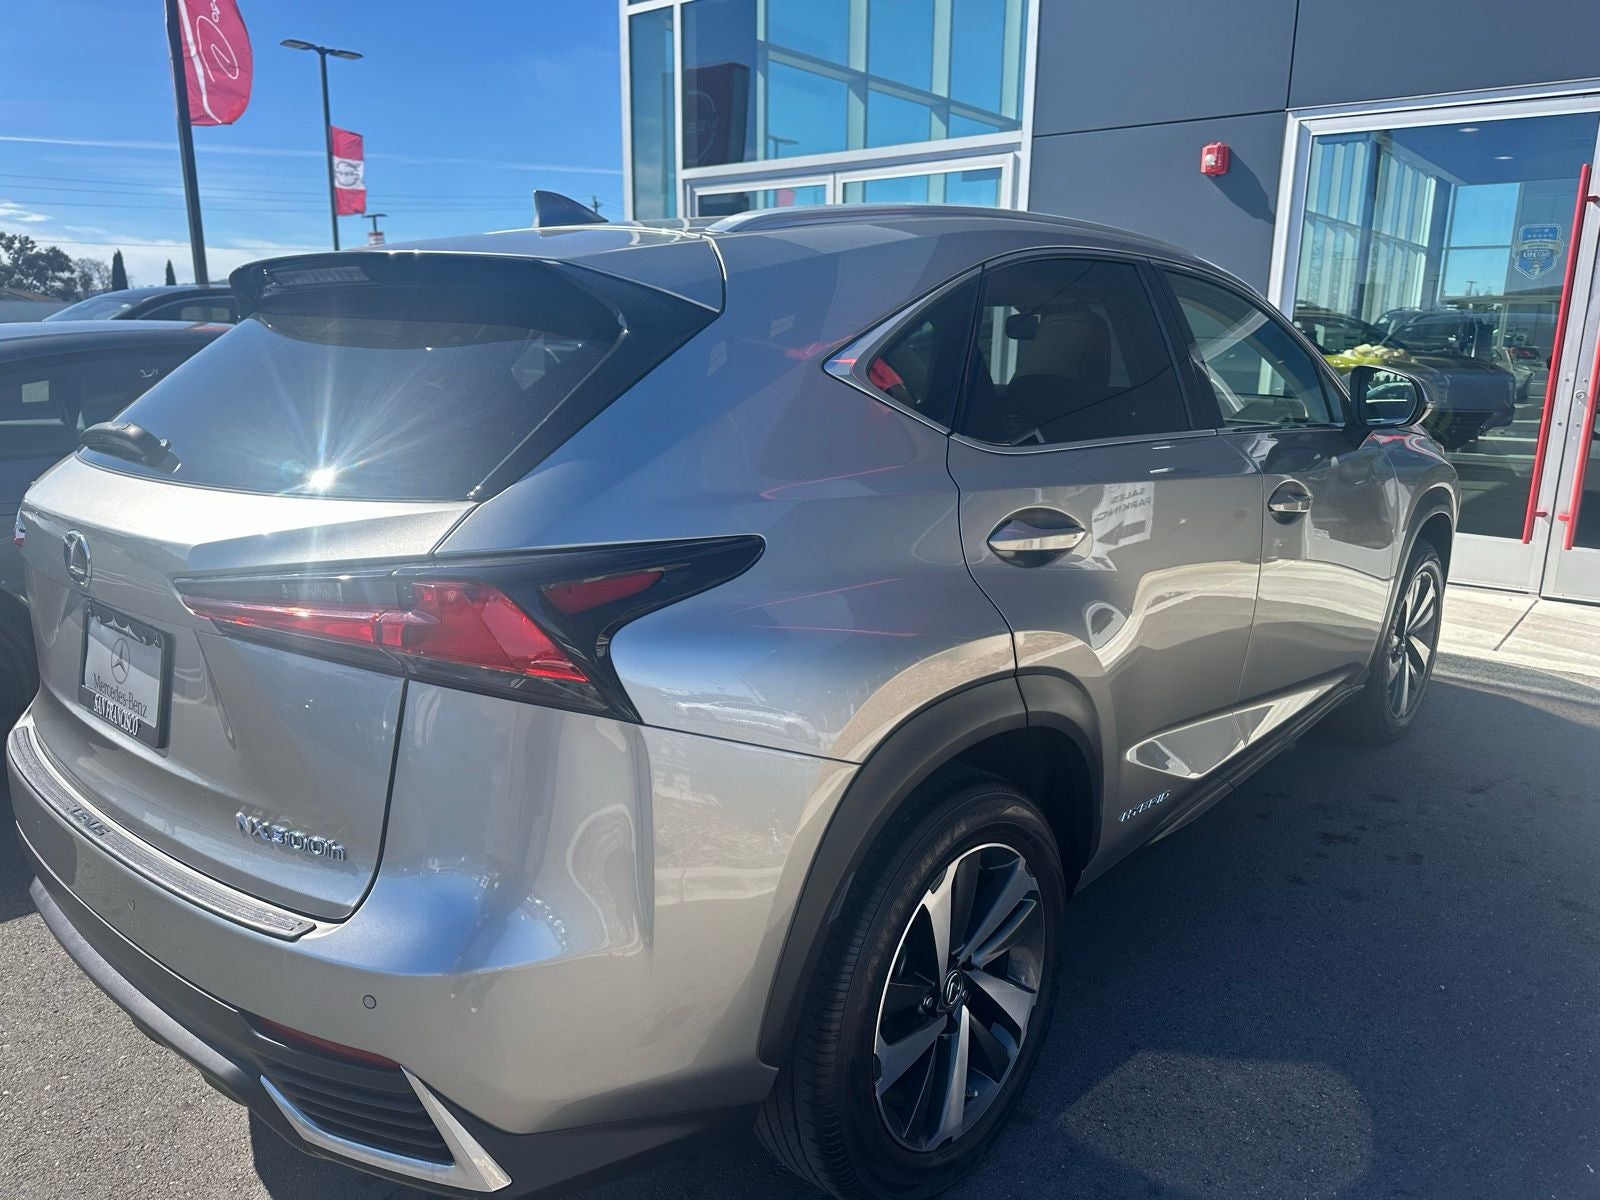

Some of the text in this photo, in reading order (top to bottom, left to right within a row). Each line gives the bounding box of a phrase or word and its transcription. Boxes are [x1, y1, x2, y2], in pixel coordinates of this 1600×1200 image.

[93, 673, 148, 718] Mercedes-Benz
[94, 693, 139, 735] SAN FRANCISCO
[1118, 790, 1171, 822] HYBRID
